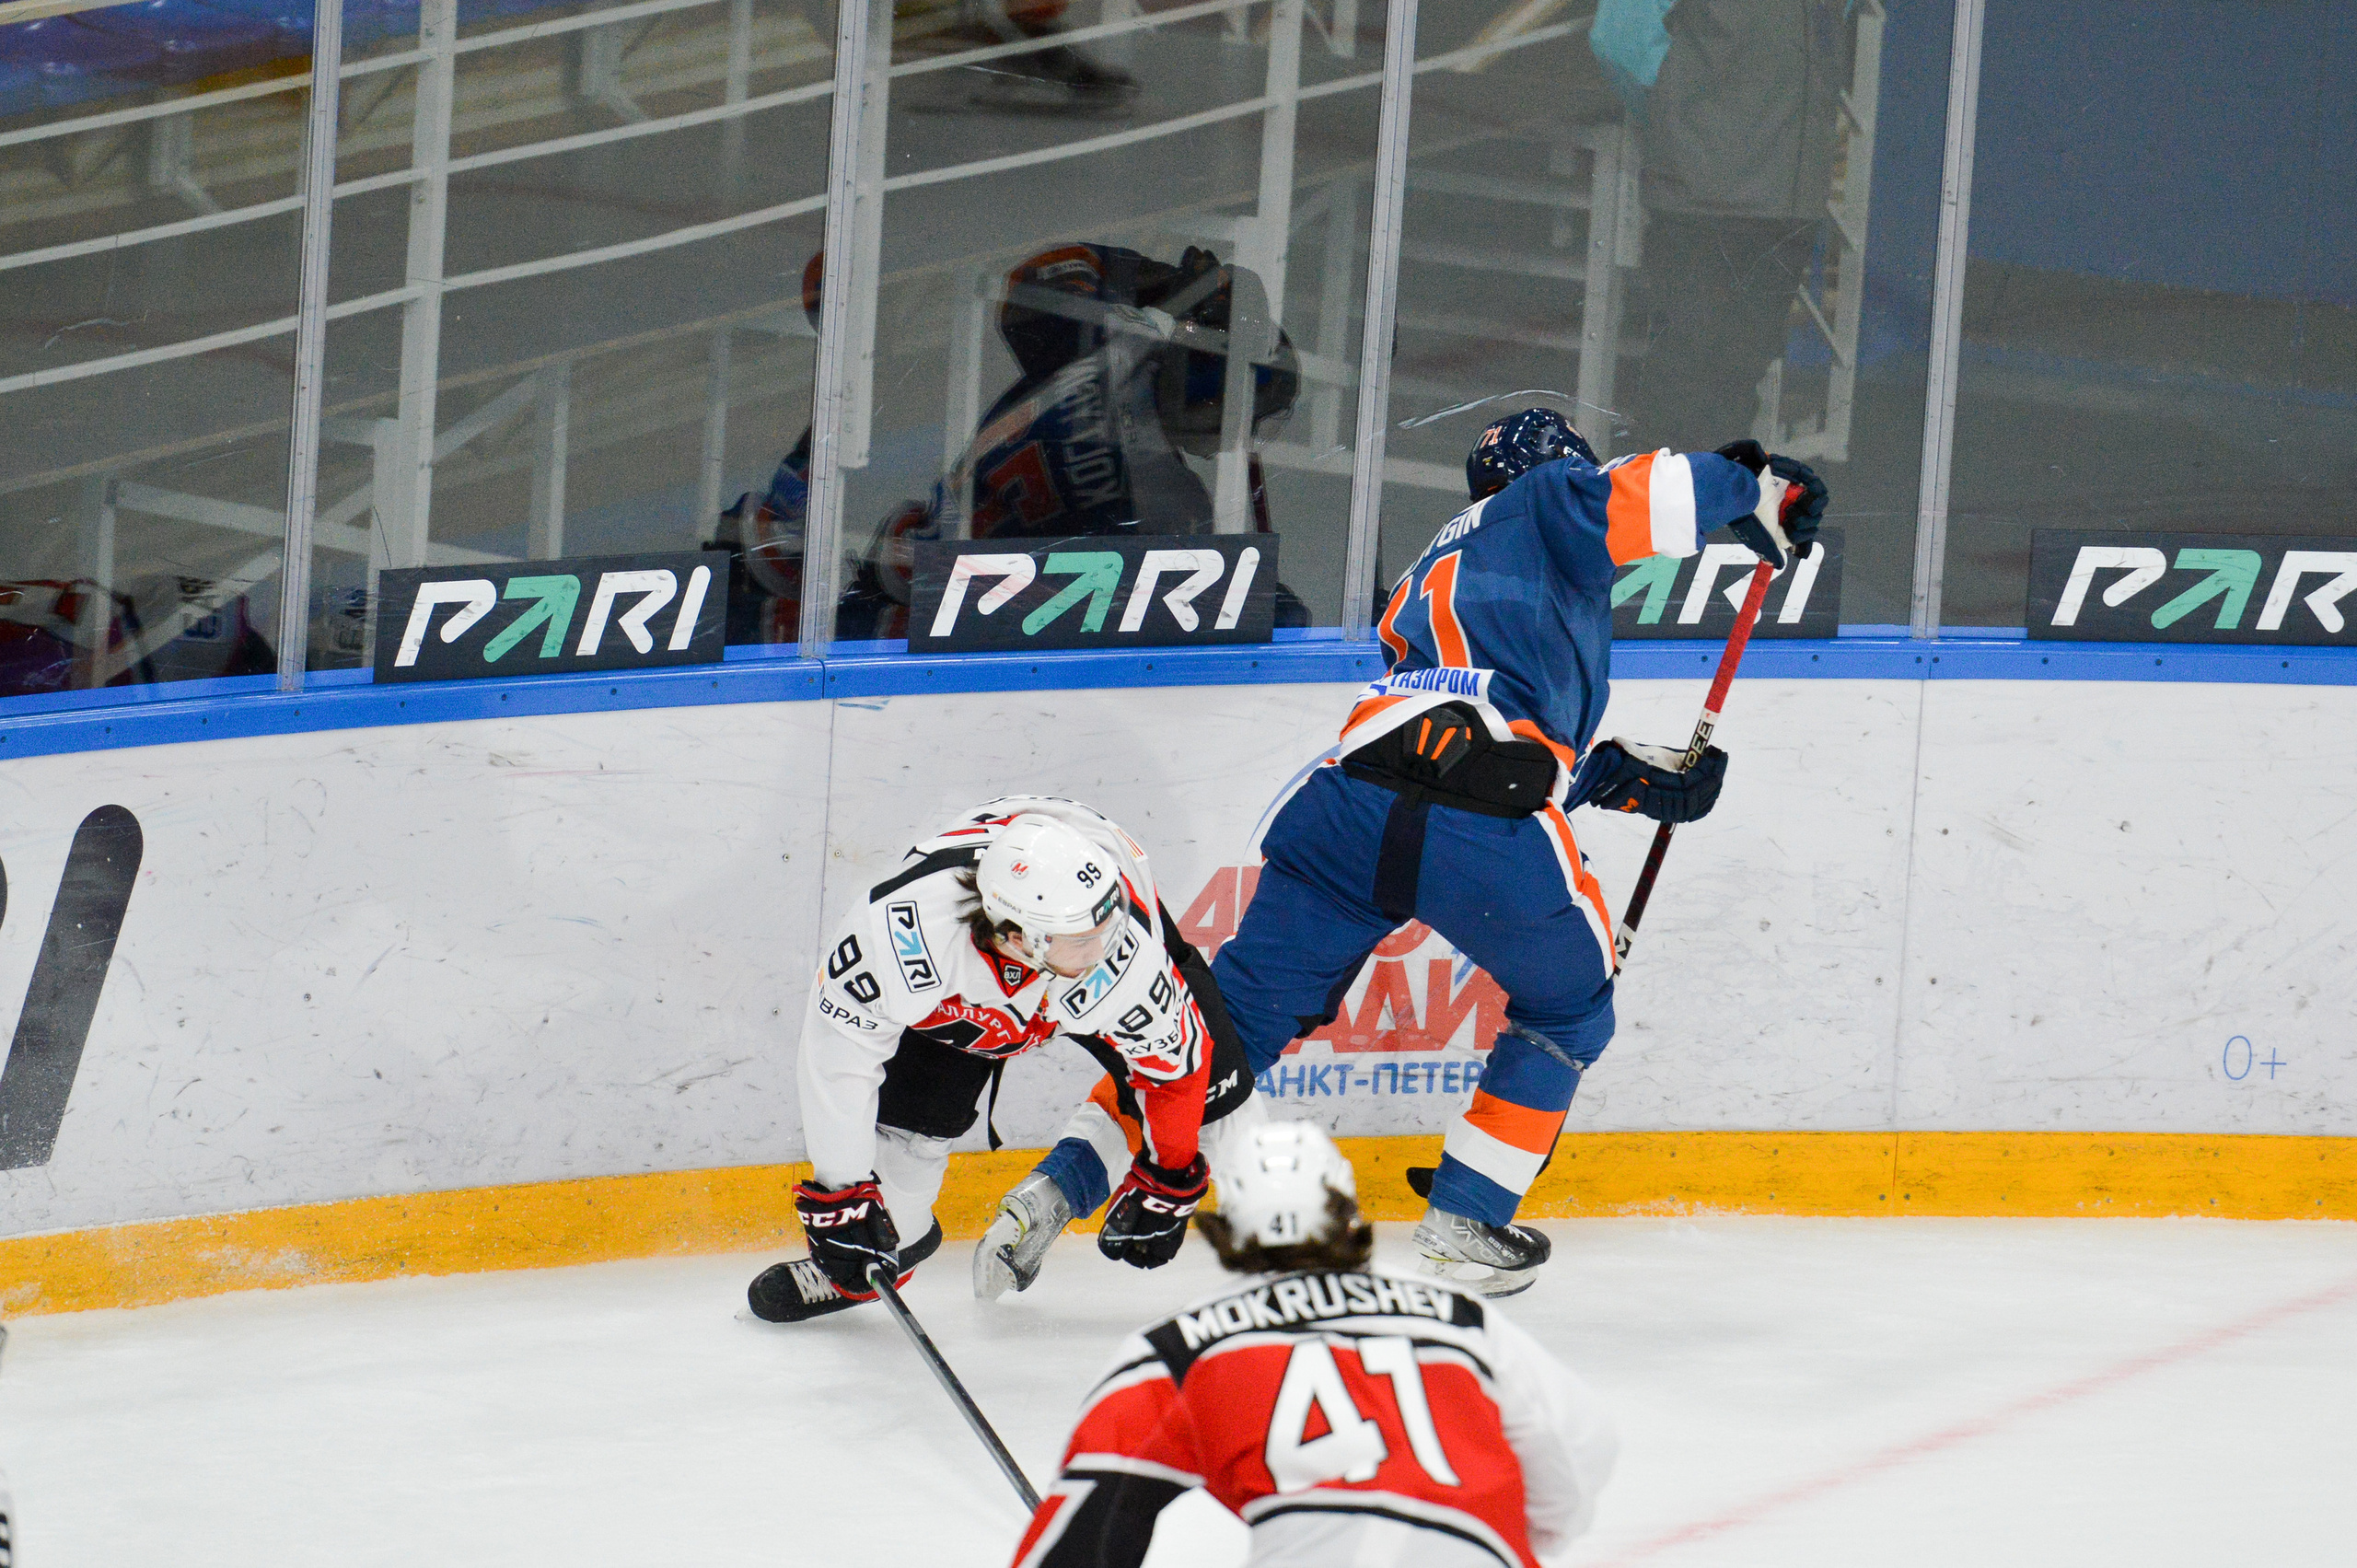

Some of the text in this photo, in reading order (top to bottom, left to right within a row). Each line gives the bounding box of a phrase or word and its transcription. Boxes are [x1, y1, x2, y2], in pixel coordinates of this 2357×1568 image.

[1480, 425, 1503, 449] 71
[930, 546, 1260, 637] PARI
[1611, 541, 1825, 624] ARI
[2050, 546, 2357, 633] PAR
[393, 565, 712, 667] PARI
[1077, 862, 1102, 889] 99
[828, 934, 881, 1004] 99
[891, 906, 936, 989] PARI
[935, 999, 1012, 1040] АЛЛУРГ
[1118, 970, 1173, 1033] 99
[1204, 1069, 1238, 1104] CM
[1254, 1061, 1485, 1098] АНКТ-ПЕТЕР
[798, 1201, 870, 1228] CCM
[1142, 1195, 1201, 1218] CC
[1269, 1212, 1298, 1236] 41
[1176, 1272, 1455, 1351] MOKRUSHEV
[1264, 1336, 1462, 1495] 41
